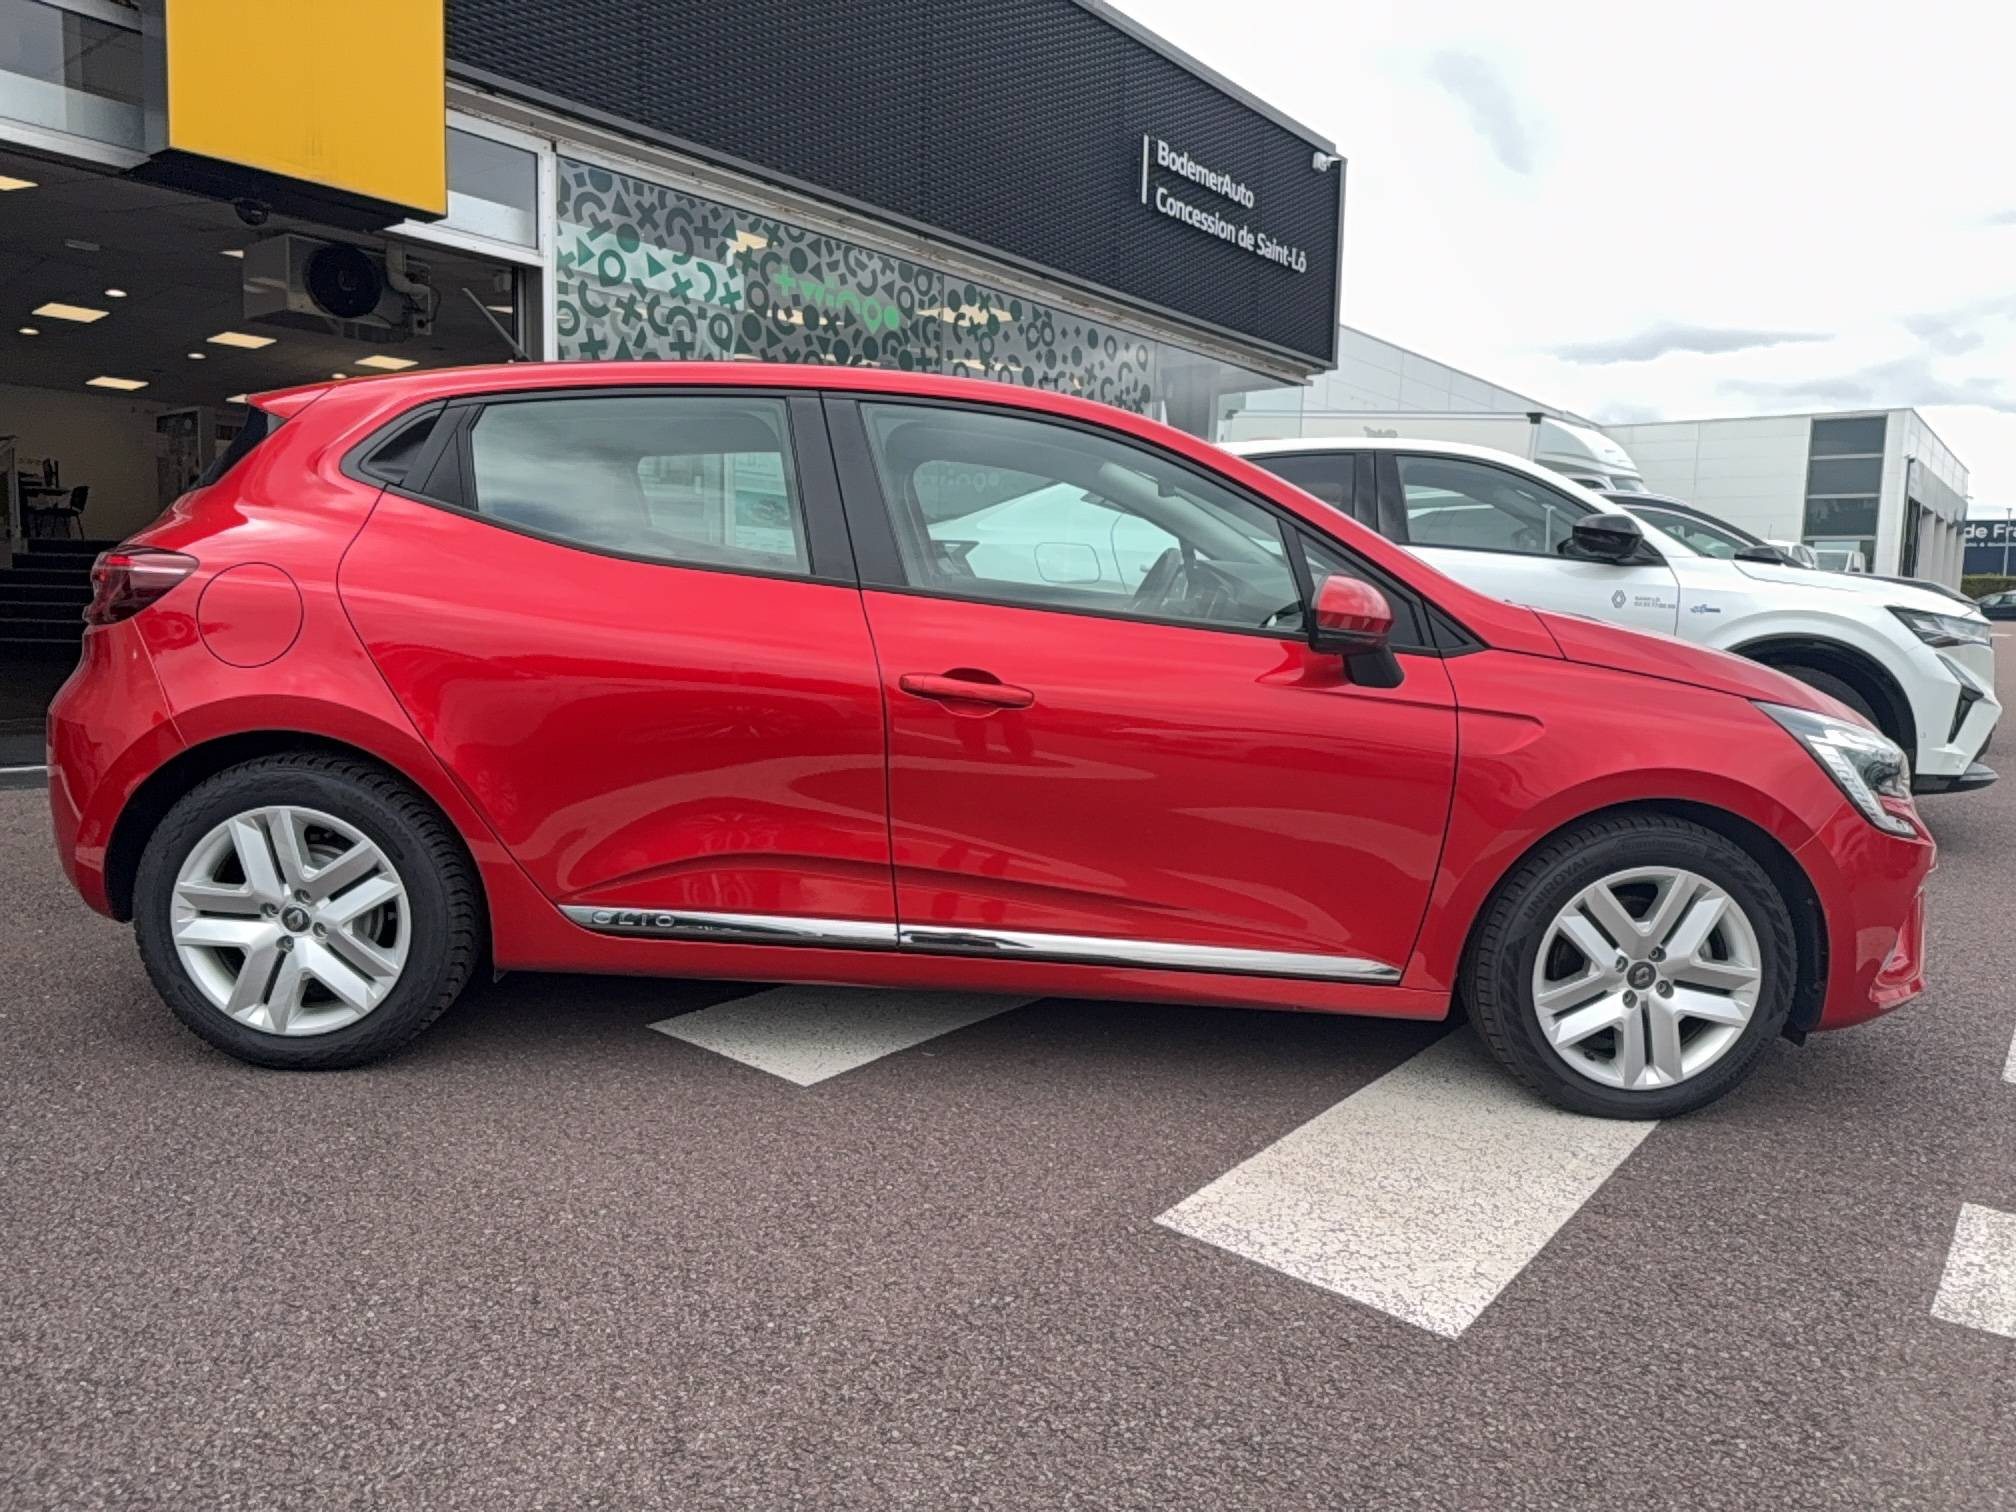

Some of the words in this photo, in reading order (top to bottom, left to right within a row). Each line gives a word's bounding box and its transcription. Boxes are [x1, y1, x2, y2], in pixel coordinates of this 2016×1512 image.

[1157, 139, 1254, 209] BodemerAuto
[1155, 186, 1235, 243] Concession
[1238, 225, 1255, 251] de
[1256, 232, 1307, 273] Saint-Lô
[1963, 523, 1988, 539] de
[593, 911, 675, 927] CLIO
